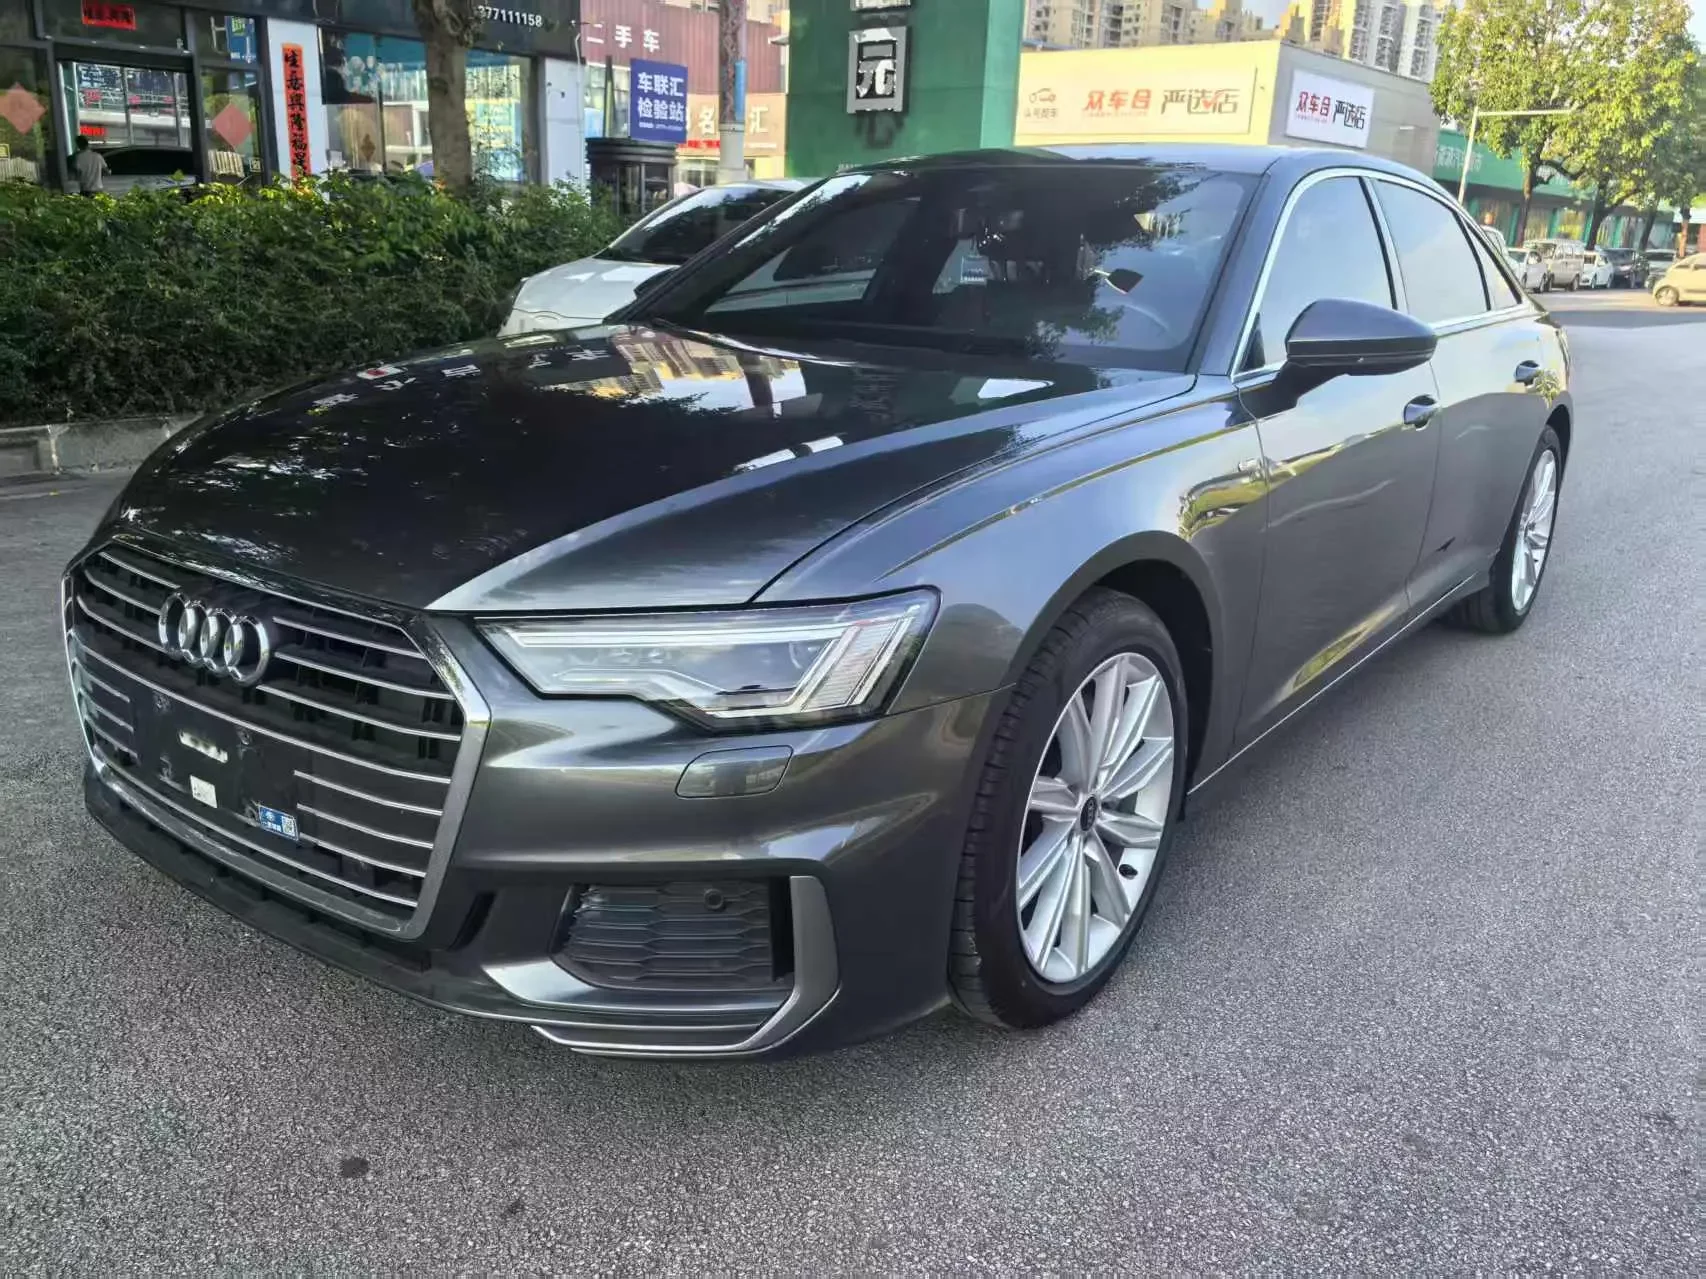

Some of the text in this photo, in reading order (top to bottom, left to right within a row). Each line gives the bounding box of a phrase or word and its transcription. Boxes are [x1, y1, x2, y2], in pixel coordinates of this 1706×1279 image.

[586, 23, 660, 52] 二手车
[637, 71, 684, 97] 车联汇
[637, 96, 685, 122] 检验站
[1160, 88, 1240, 115] 严选店
[1332, 99, 1367, 130] 严选店
